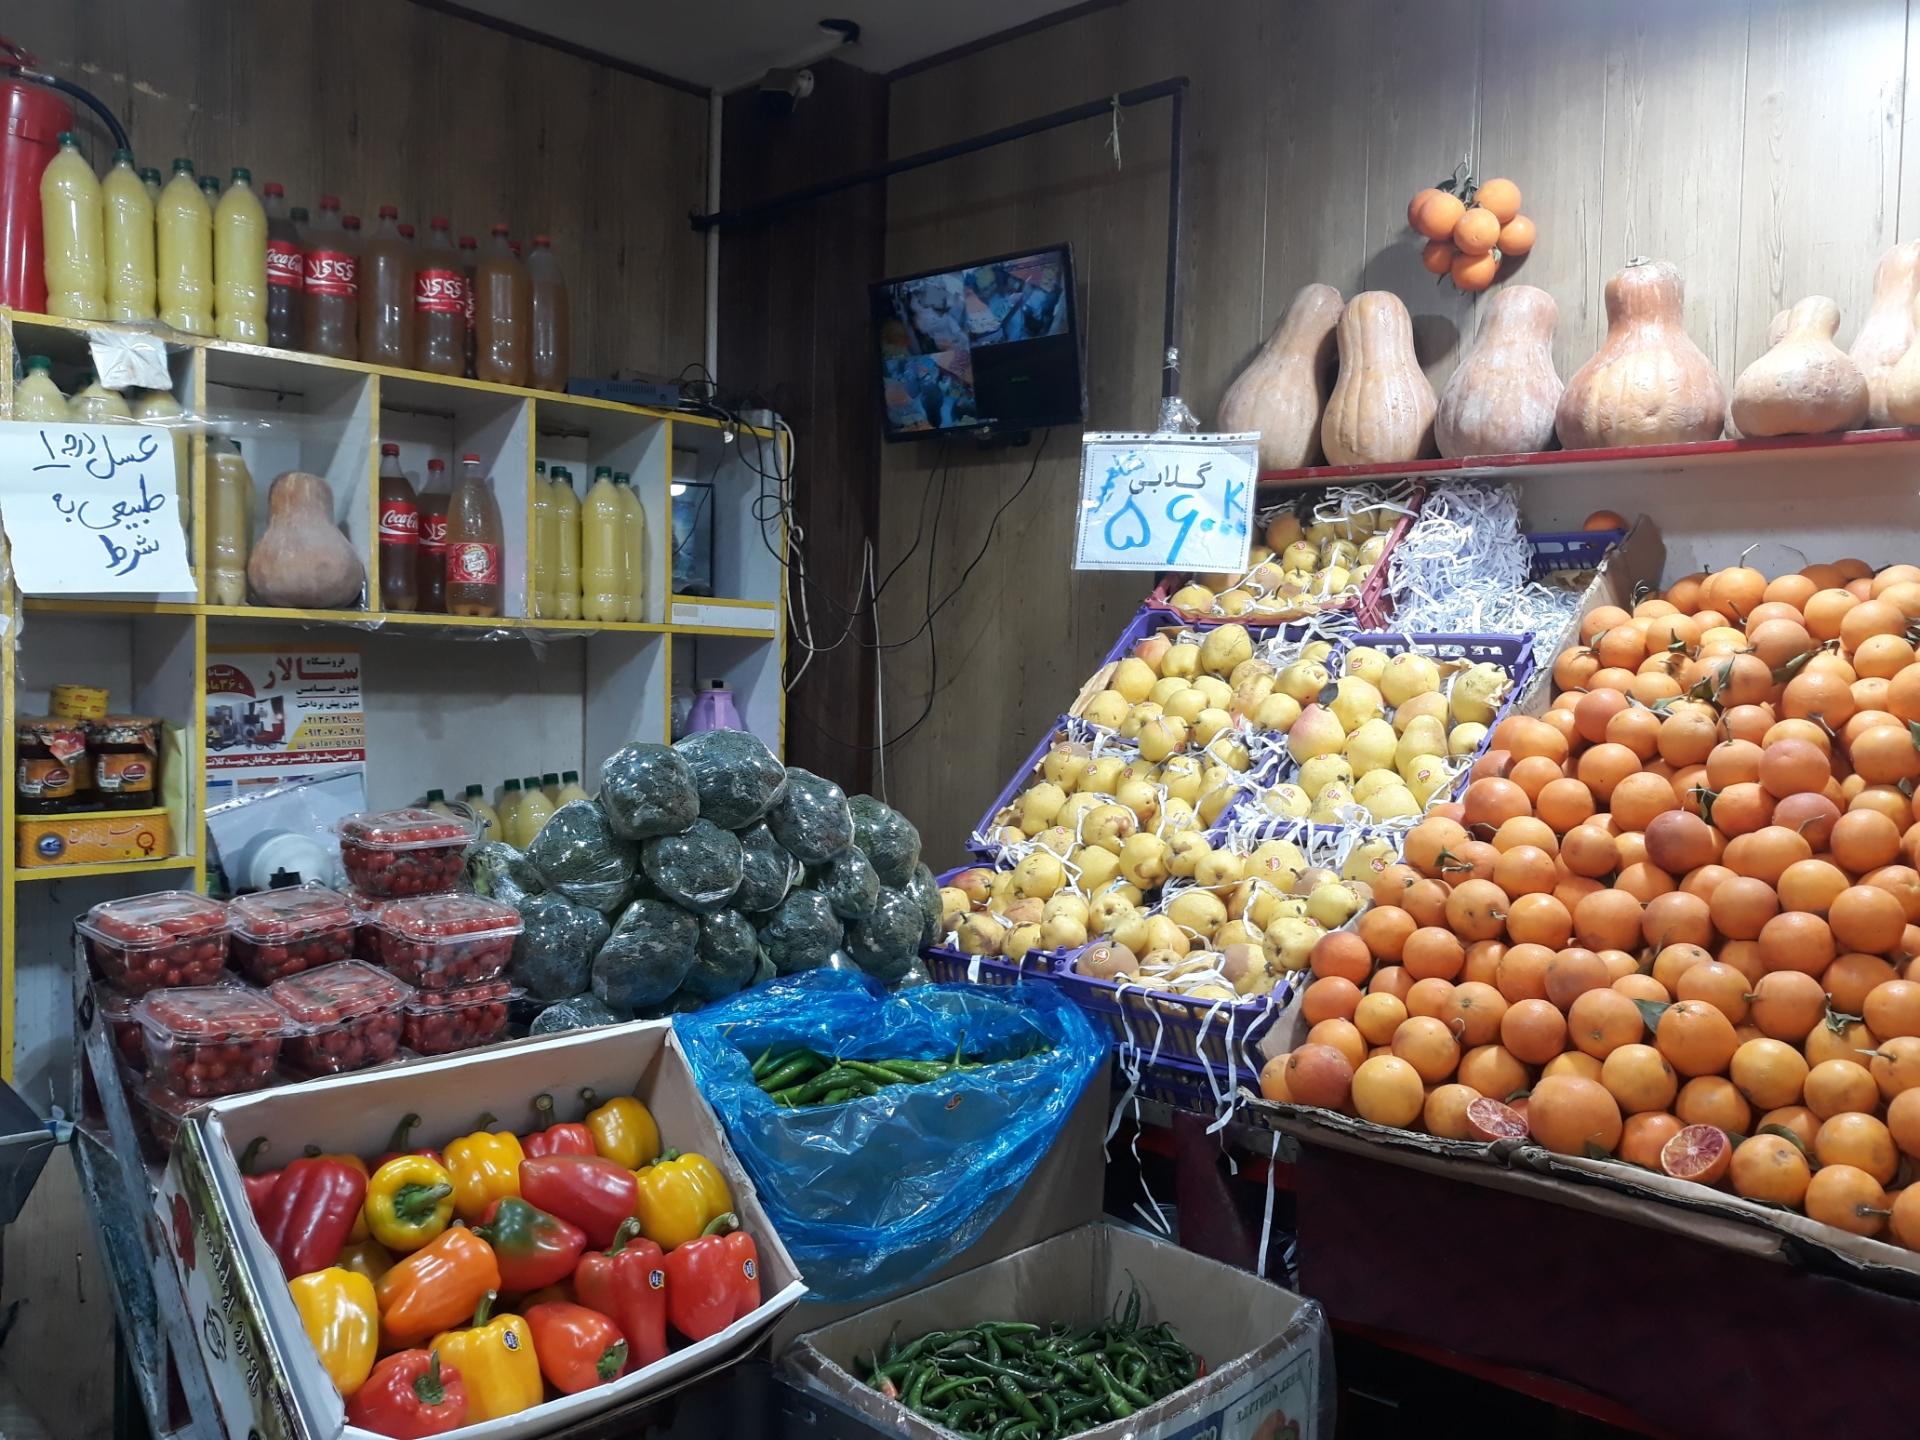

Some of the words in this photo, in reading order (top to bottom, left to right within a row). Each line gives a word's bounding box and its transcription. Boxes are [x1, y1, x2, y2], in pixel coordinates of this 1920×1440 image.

[86, 434, 158, 479] عسل
[1128, 461, 1214, 494] گلابی
[51, 492, 75, 523] به
[77, 473, 166, 529] طبیعی
[97, 534, 160, 577] شرط
[261, 656, 358, 689] سالار
[306, 656, 345, 668] فروشگاه
[338, 685, 359, 694] بدون
[341, 701, 359, 709] بدون
